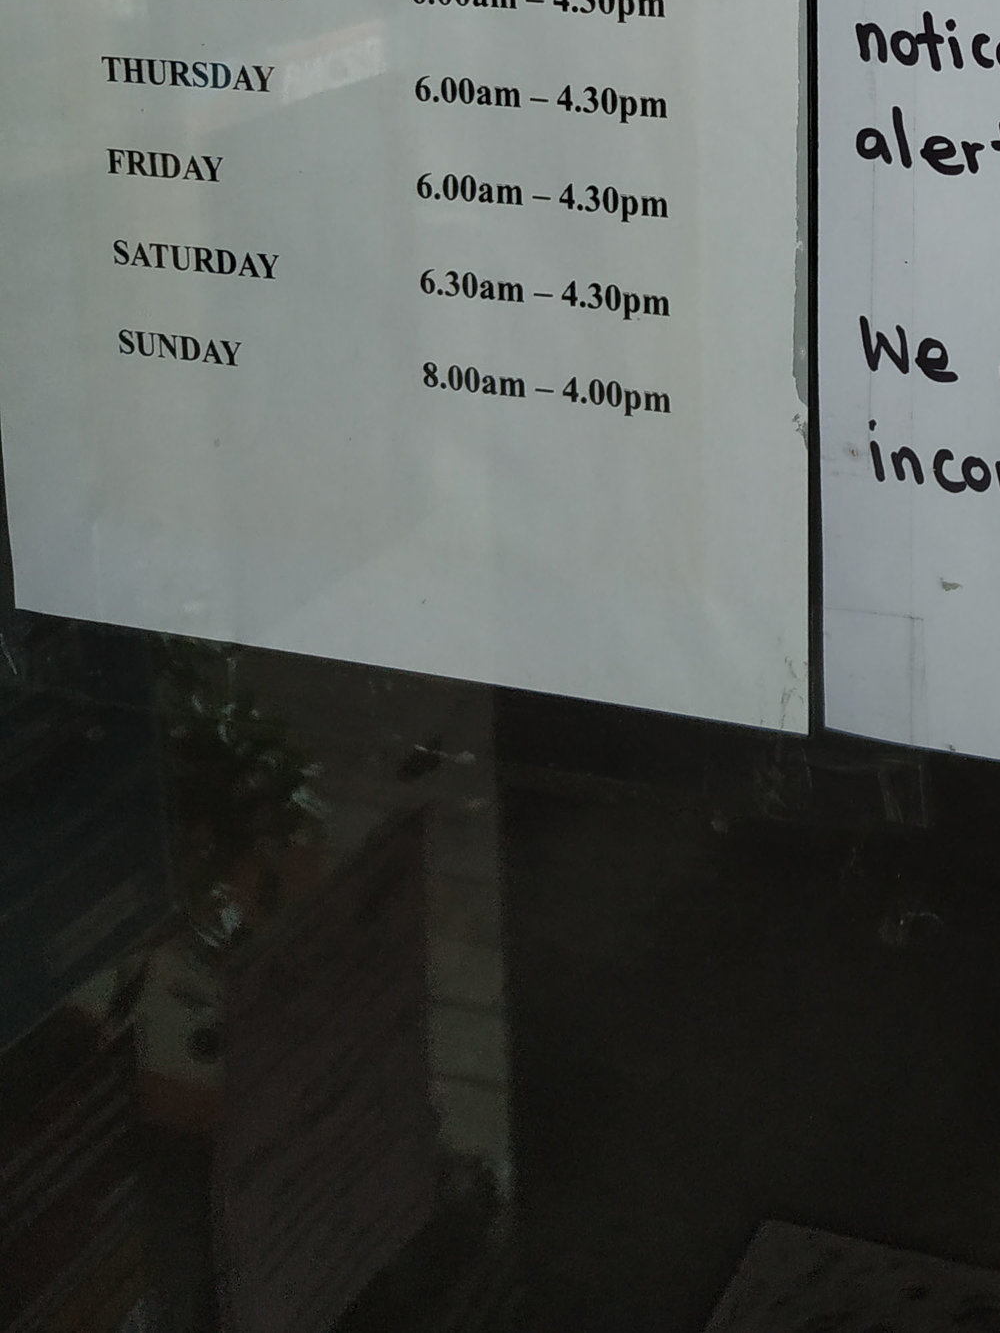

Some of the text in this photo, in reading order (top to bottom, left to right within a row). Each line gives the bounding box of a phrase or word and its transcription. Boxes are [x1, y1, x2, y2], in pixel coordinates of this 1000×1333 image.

[100, 56, 275, 93] THURSDAY
[414, 75, 522, 108] 6.00am
[556, 84, 668, 124] 4.30pm
[106, 148, 224, 183] FRIDAY
[416, 172, 524, 206] 6.00am
[558, 183, 669, 223] 4.30pm
[113, 239, 280, 280] SATURDAY
[419, 268, 525, 303] 6.30am
[561, 280, 671, 321] 4.30pm
[118, 329, 242, 367] SUNDAY
[422, 361, 526, 398] 8.00am
[562, 376, 671, 417] 4.00pm
[859, 315, 959, 383] We
